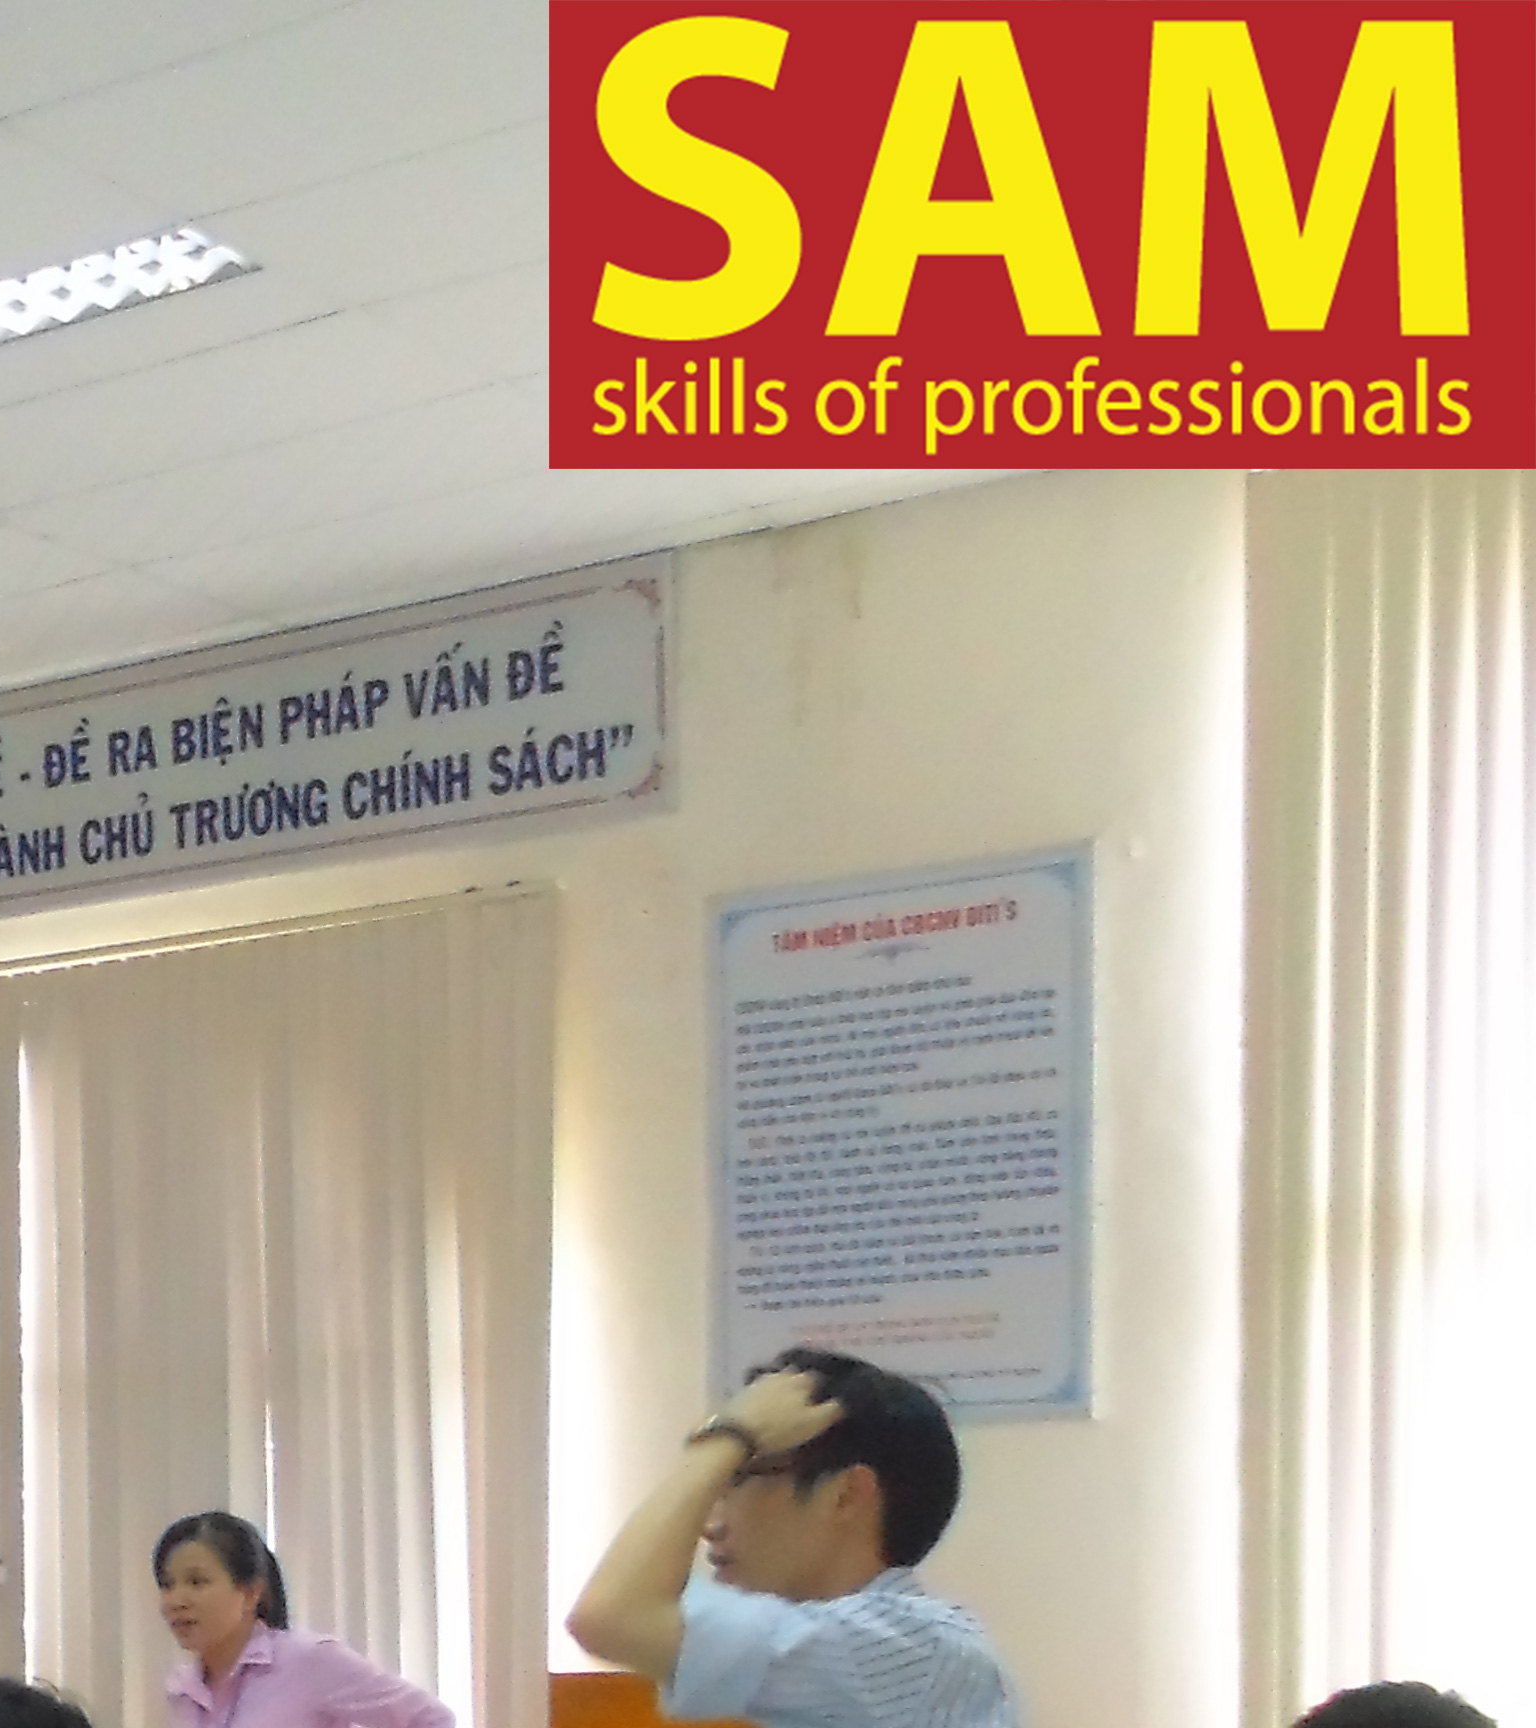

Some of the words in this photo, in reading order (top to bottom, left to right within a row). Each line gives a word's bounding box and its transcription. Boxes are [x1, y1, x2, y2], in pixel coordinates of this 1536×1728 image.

[43, 718, 91, 788] ĐỀ
[108, 725, 158, 777] RA
[172, 697, 264, 767] BIỆN
[279, 671, 389, 745] PHÁP
[403, 641, 490, 719] VẤN
[506, 620, 564, 701] ĐỀ
[80, 792, 154, 865] CHỦ
[169, 779, 328, 849] TRƯƠNG
[342, 750, 471, 821] CHÍNH
